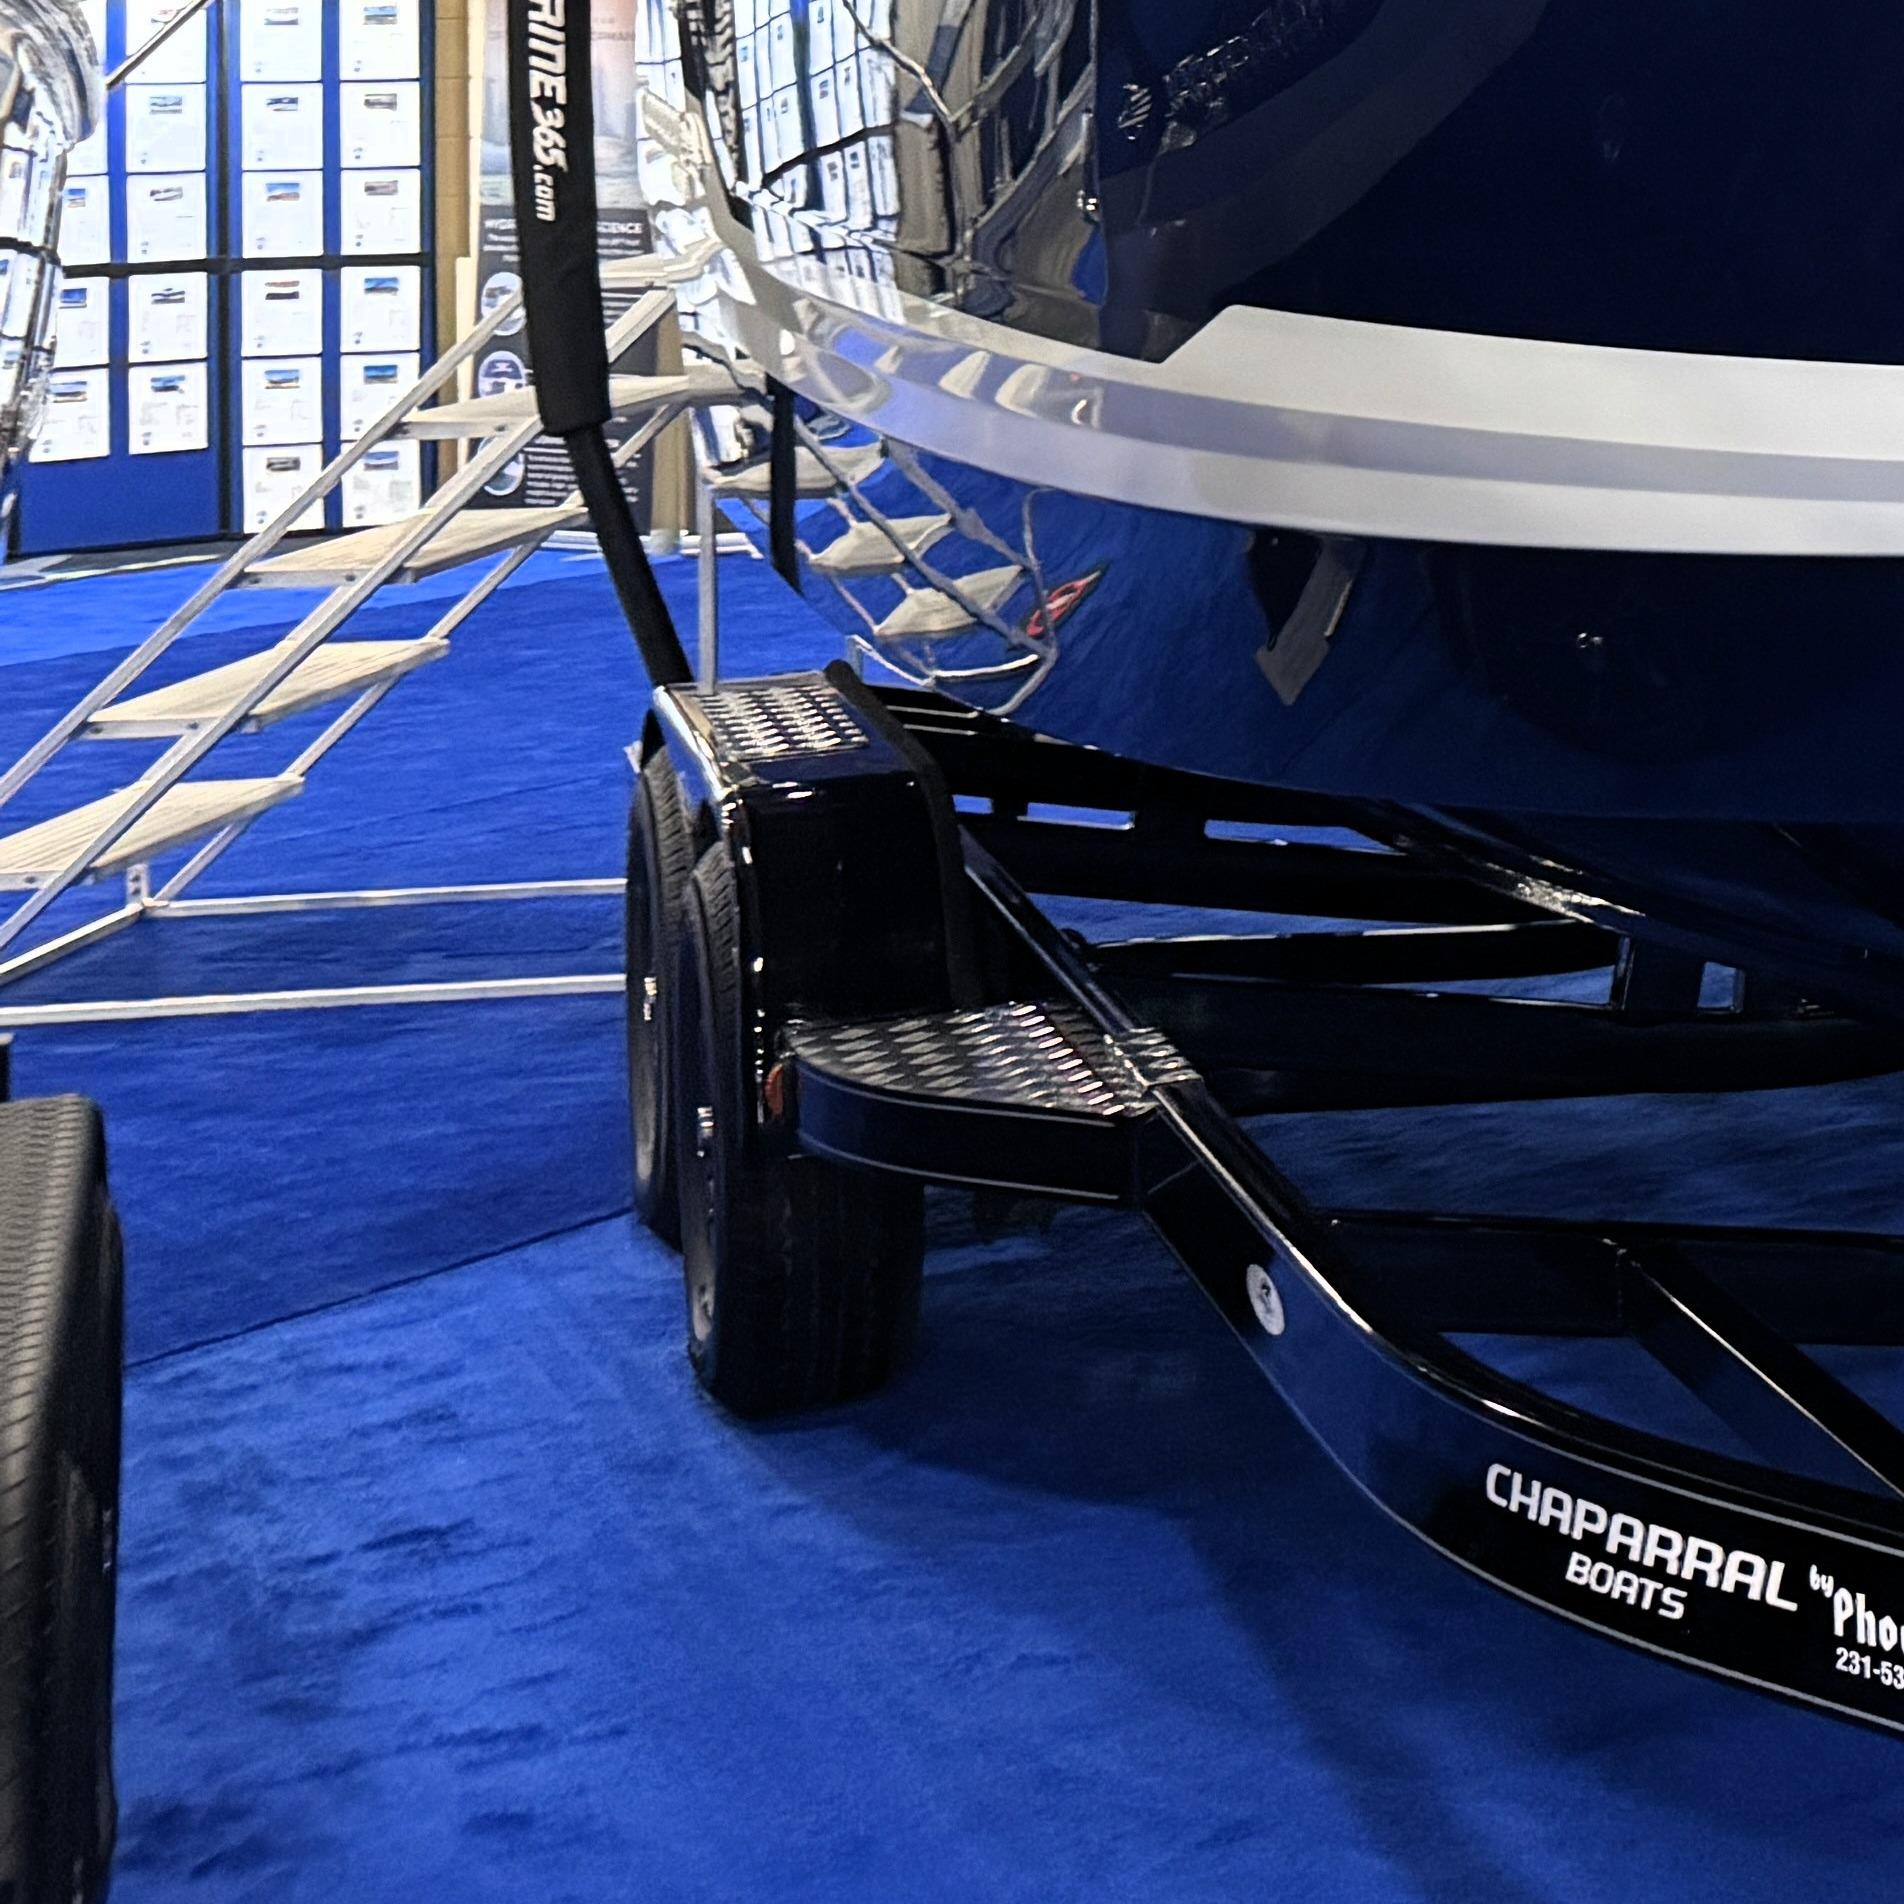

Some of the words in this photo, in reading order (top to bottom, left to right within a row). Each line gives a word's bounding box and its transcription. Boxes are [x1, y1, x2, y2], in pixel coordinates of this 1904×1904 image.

[1485, 1463, 1798, 1612] CHAPARRAL
[1564, 1551, 1688, 1620] BOATS
[1809, 1564, 1834, 1598] by
